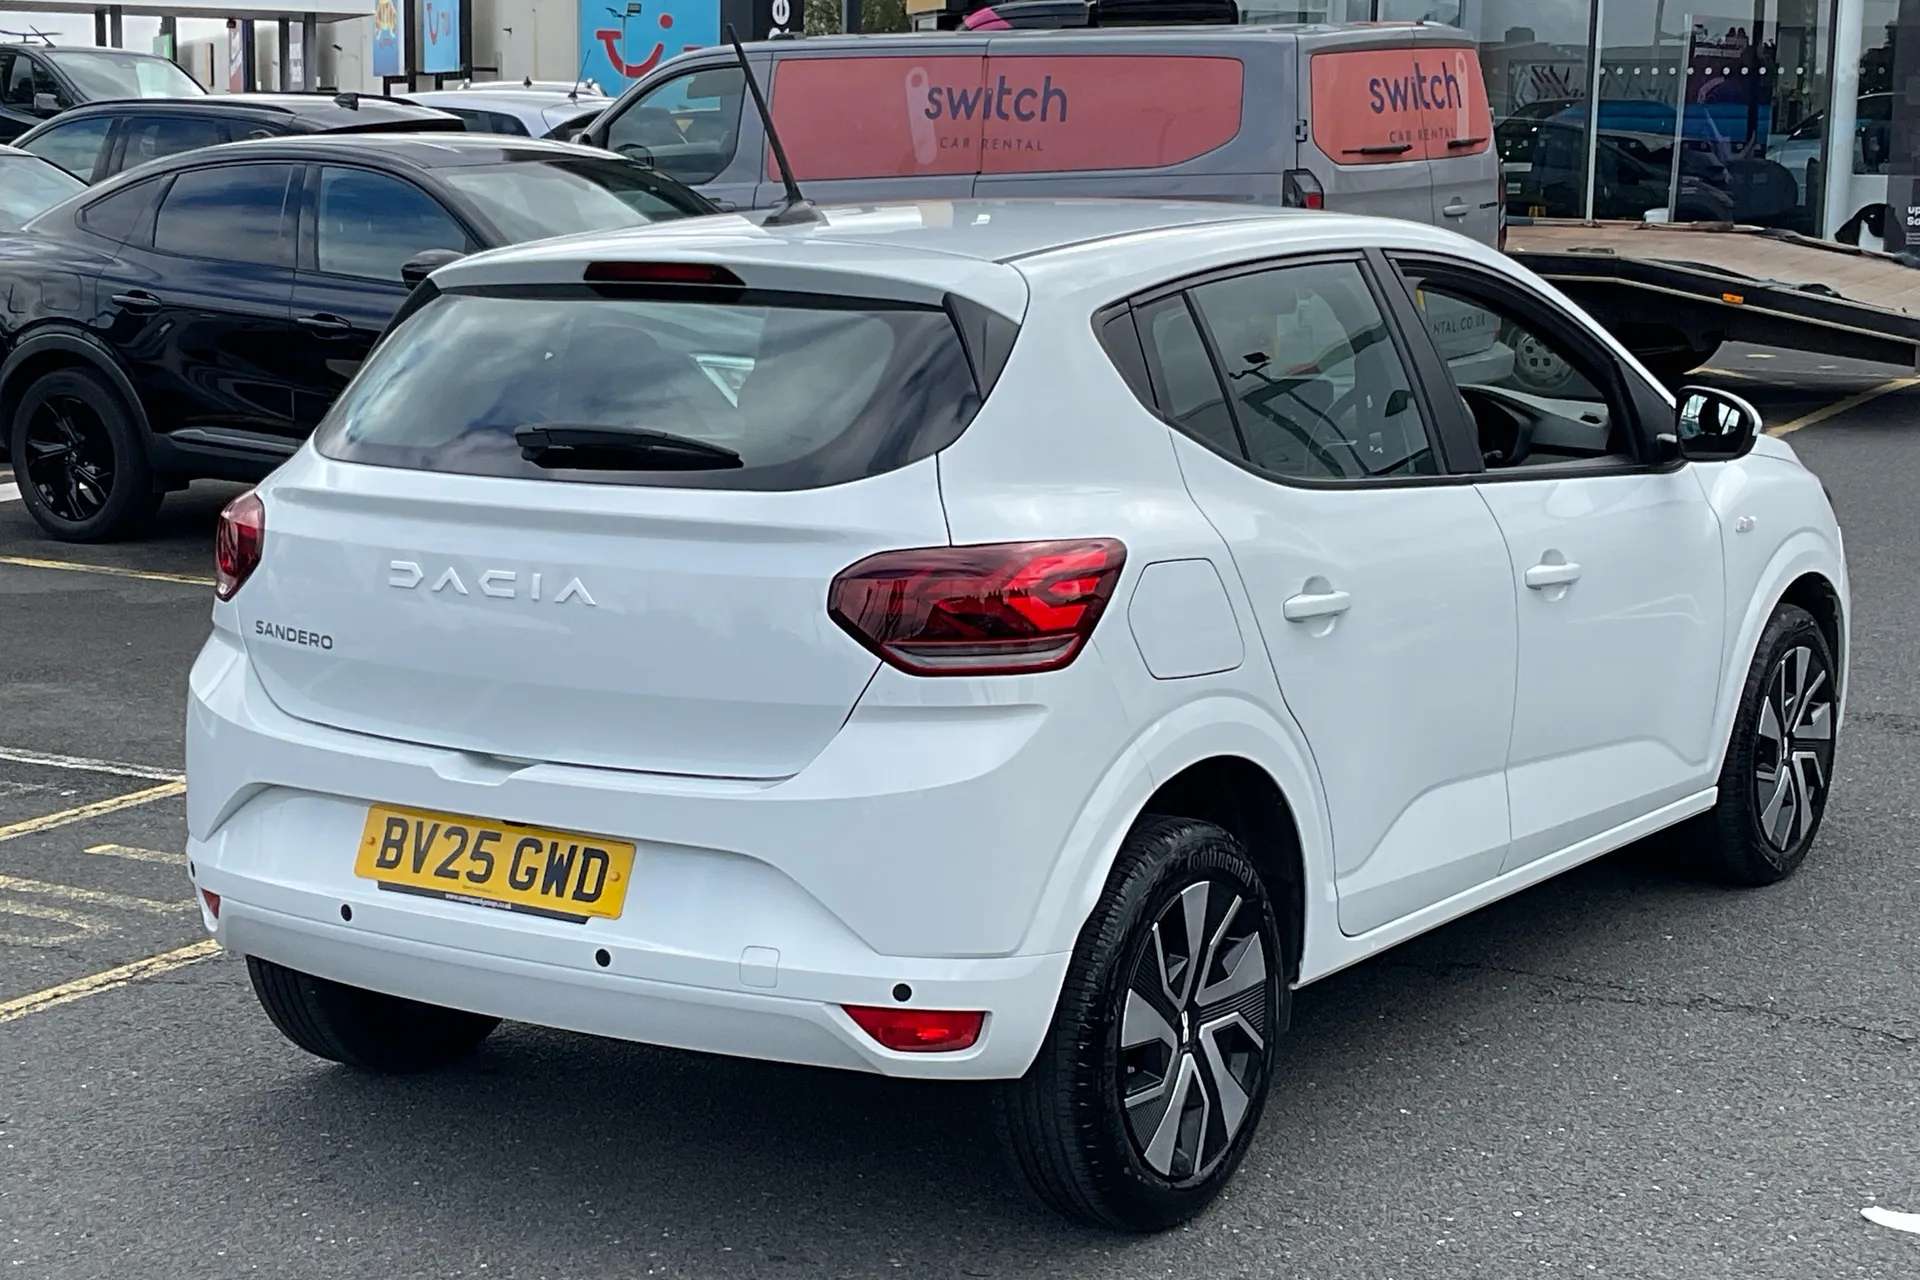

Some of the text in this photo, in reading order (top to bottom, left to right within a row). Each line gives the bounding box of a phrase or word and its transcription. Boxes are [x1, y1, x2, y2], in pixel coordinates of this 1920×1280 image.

[596, 13, 703, 79] TU
[925, 75, 1068, 123] switch
[1369, 61, 1462, 114] switch
[940, 137, 1045, 151] CAR RENTAL
[1389, 128, 1457, 143] CAR RENTAL
[388, 559, 598, 607] DACIA
[255, 619, 334, 651] SANDERO
[375, 817, 613, 904] BV25 GWD
